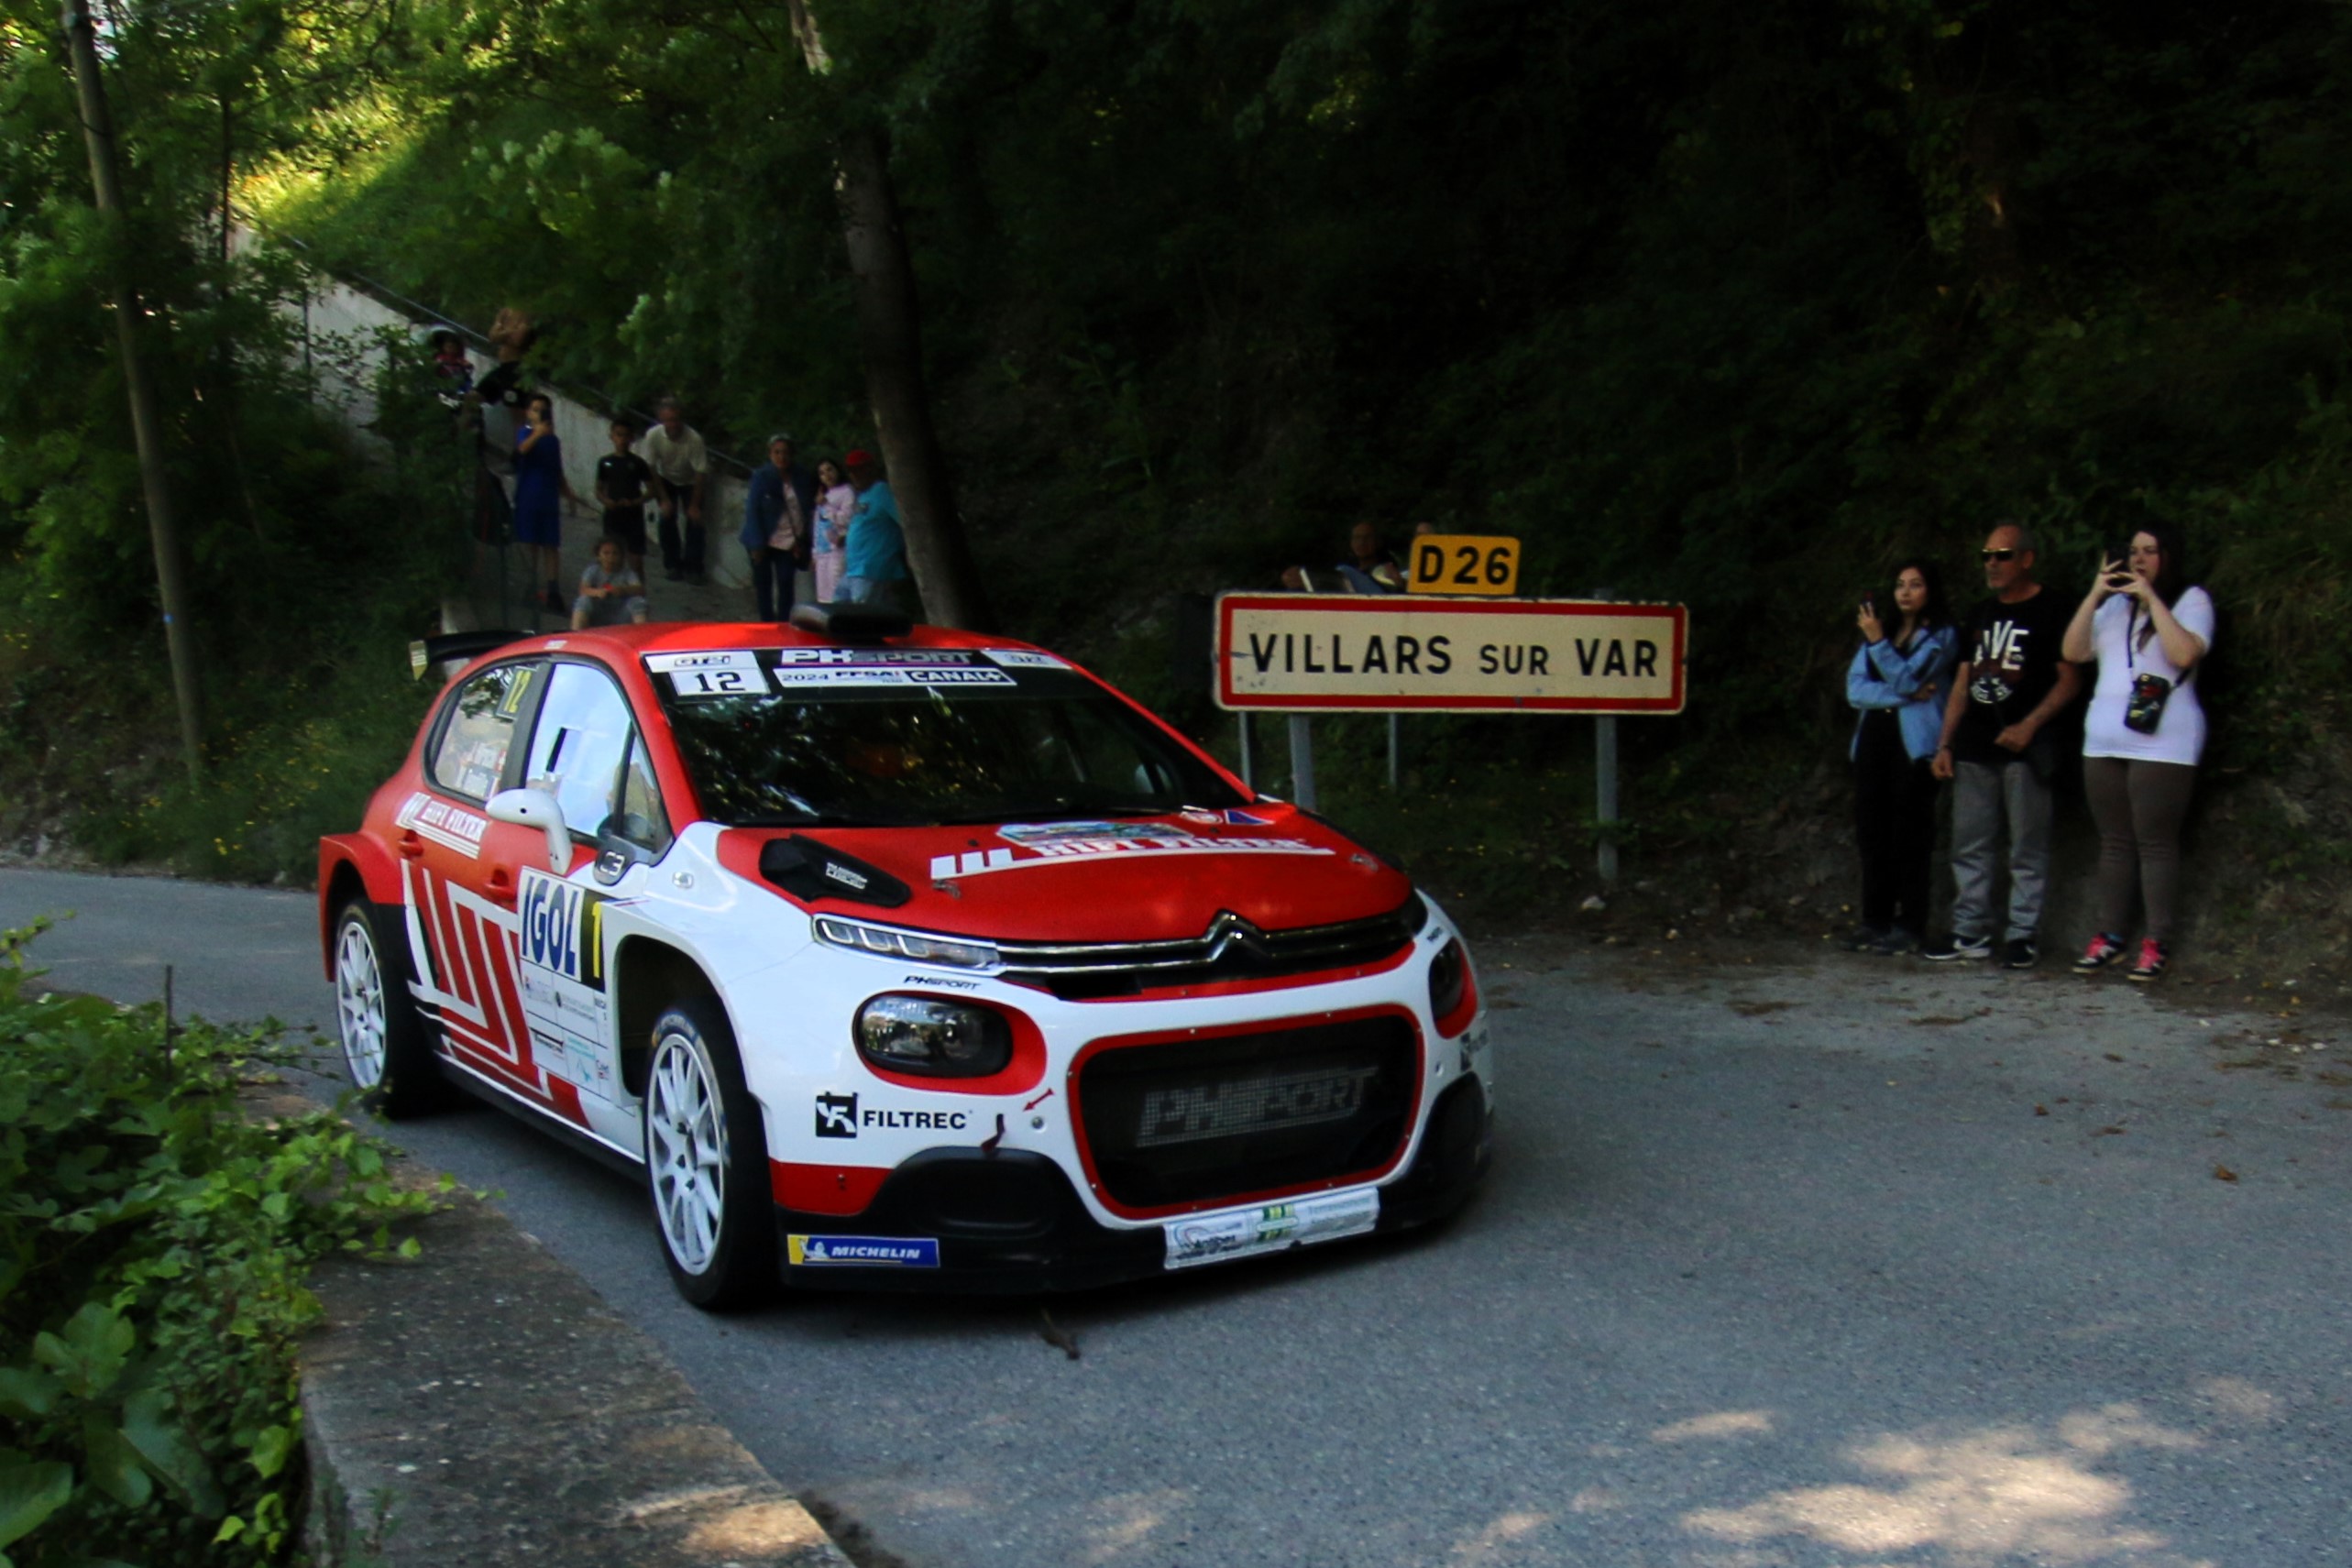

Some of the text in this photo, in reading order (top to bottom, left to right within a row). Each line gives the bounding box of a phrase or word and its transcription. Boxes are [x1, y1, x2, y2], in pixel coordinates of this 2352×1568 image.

[1249, 632, 1658, 678] VILLARS SUR VAR
[694, 672, 746, 693] 12
[782, 673, 829, 681] 2024
[522, 875, 580, 978] IGOL
[863, 1109, 967, 1130] FILTREC
[830, 1245, 920, 1259] MICHELIN
